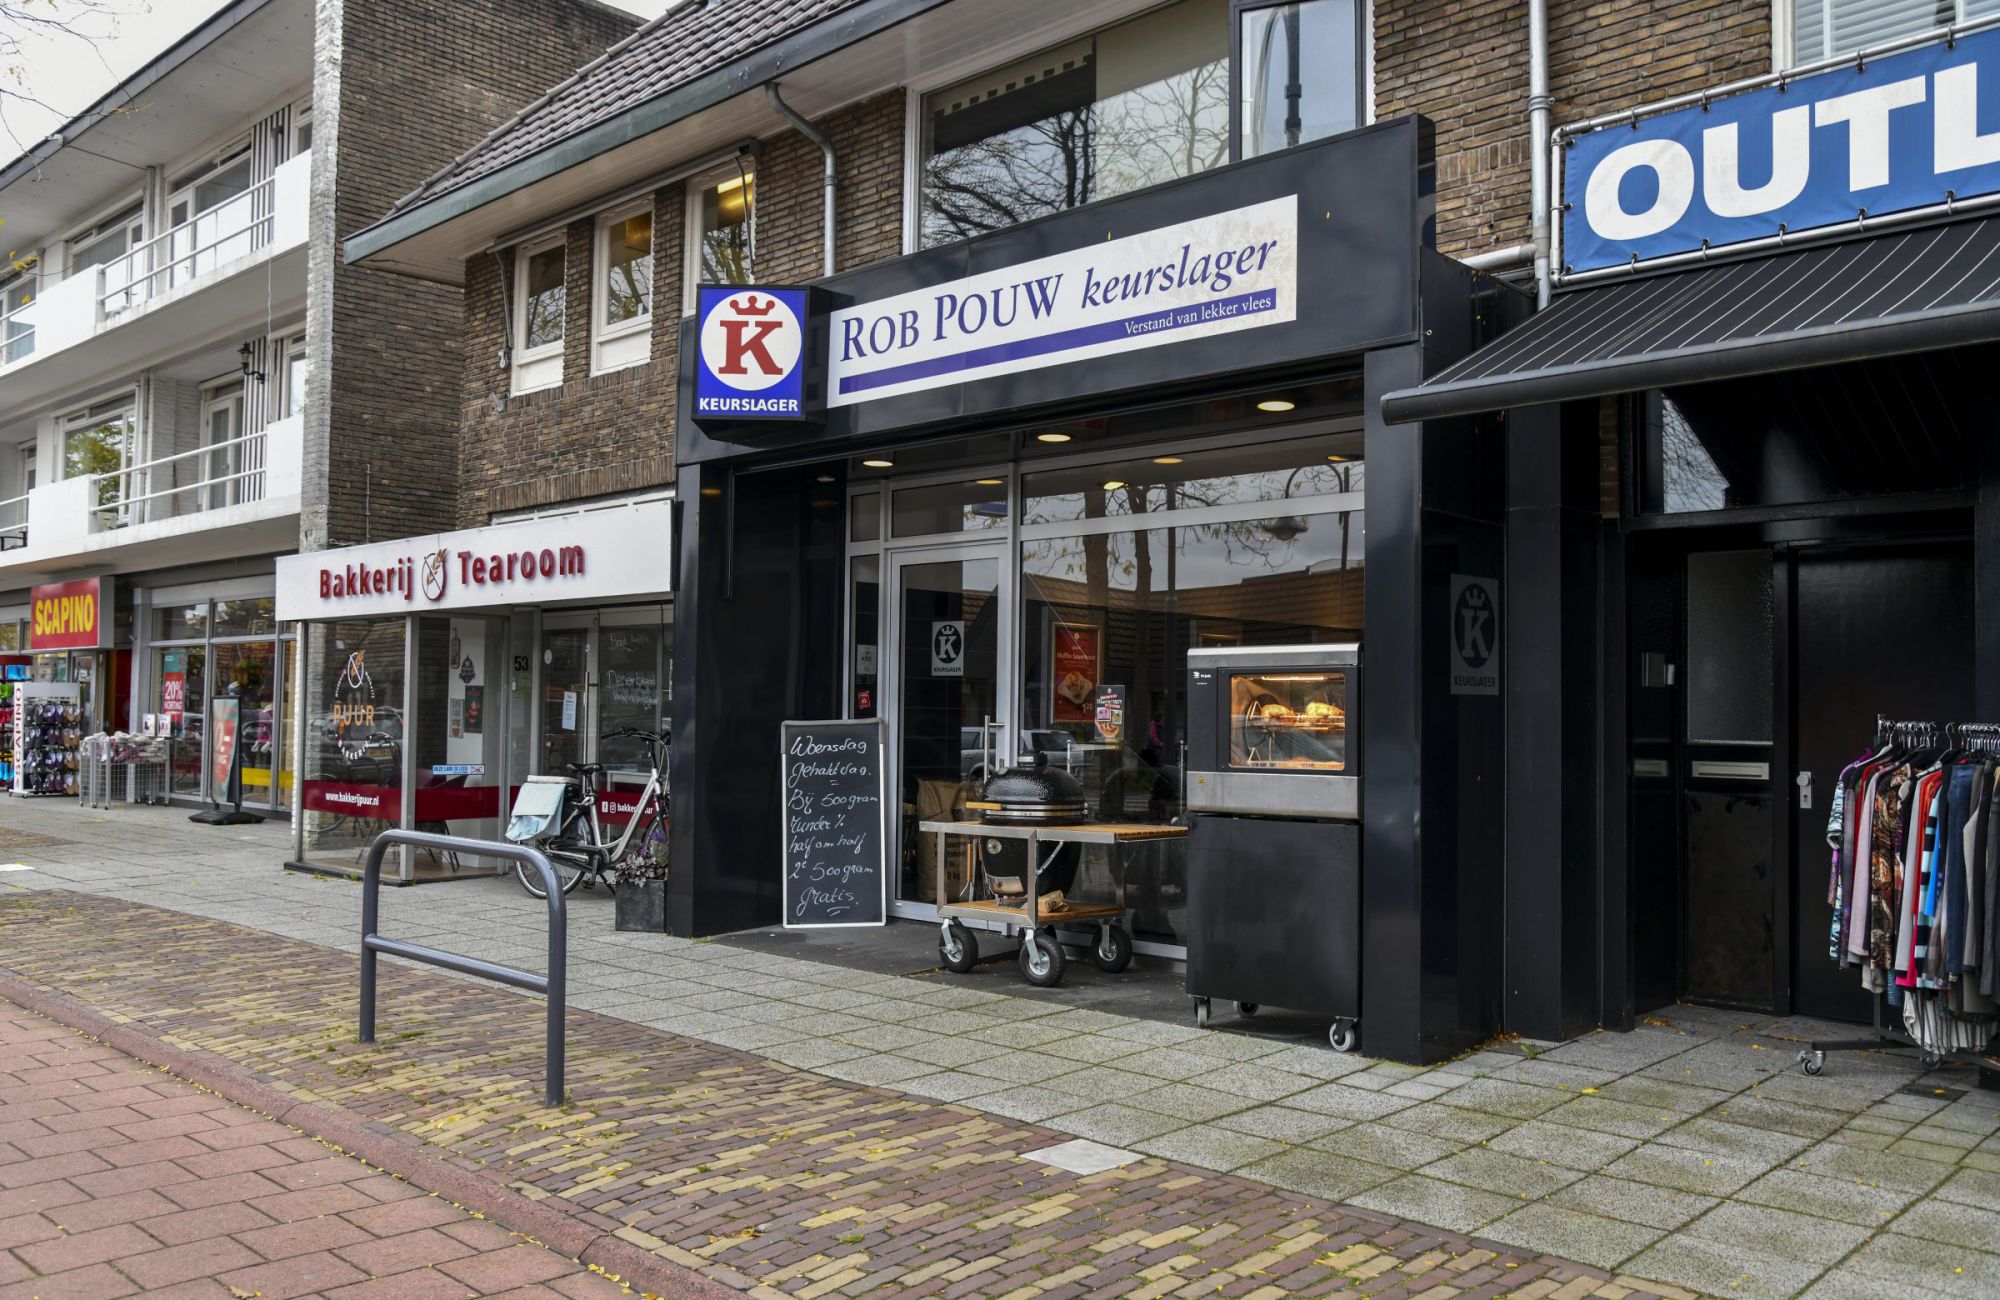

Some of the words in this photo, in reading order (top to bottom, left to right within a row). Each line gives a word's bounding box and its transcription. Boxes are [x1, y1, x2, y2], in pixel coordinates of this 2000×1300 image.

[840, 312, 920, 363] ROB
[934, 274, 1063, 342] POUW
[1080, 239, 1277, 310] keurslager
[1124, 312, 1174, 335] Verstand
[1176, 312, 1198, 325] van
[1200, 303, 1239, 321] lekker
[1242, 296, 1272, 312] vlees
[698, 396, 799, 413] KEURSLAGER
[319, 556, 413, 601] Bakkerij
[458, 545, 585, 585] Tearoom
[34, 593, 95, 637] SCAPINO
[514, 655, 529, 671] 53
[164, 680, 183, 700] 20%
[1454, 675, 1496, 688] KEURSLAGER
[333, 703, 375, 727] PUUR
[790, 735, 867, 757] Woensdag
[325, 791, 380, 807] www.bakkerijpuur.nl
